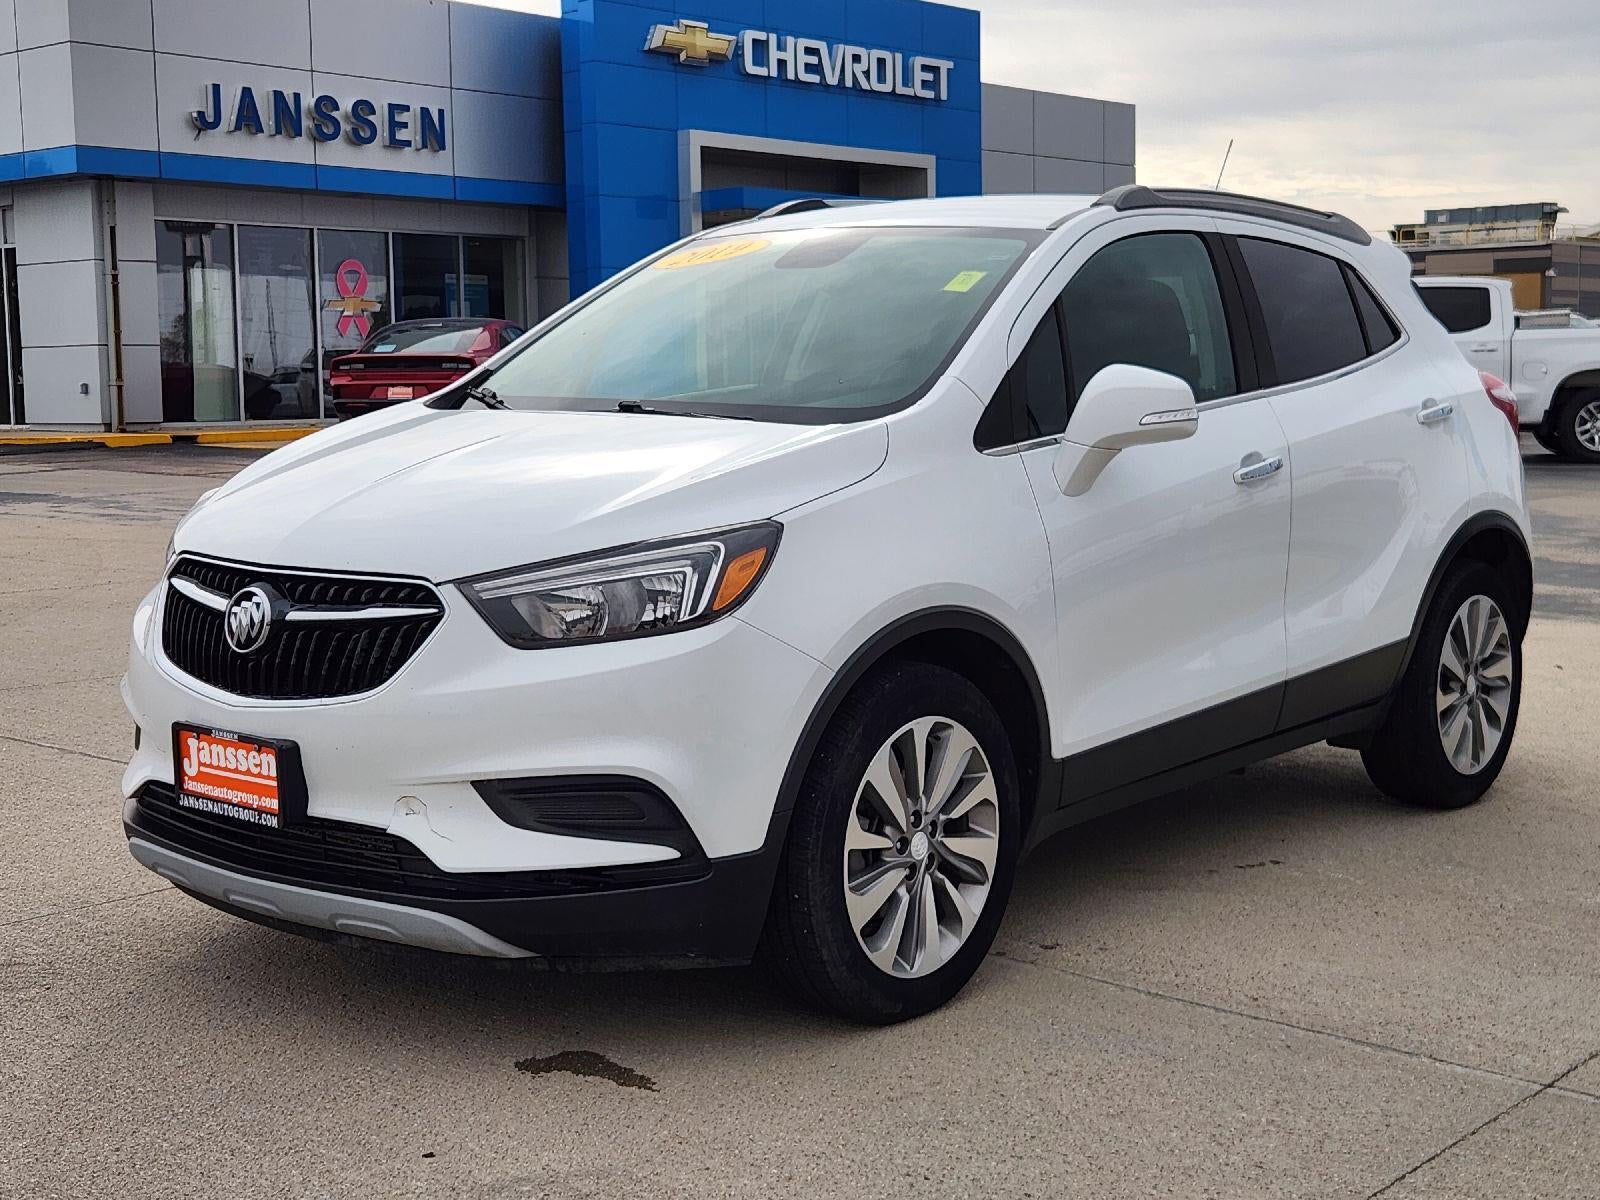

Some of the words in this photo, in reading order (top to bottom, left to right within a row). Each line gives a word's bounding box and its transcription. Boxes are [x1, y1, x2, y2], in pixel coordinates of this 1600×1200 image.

[740, 29, 954, 101] CHEVROLET
[192, 83, 447, 152] JANSSEN
[211, 729, 239, 740] JANSSEN
[183, 737, 278, 777] Janssen
[183, 776, 279, 809] Janssenautogroup.com
[179, 794, 279, 829] JANSSENAUTOGROUP.COM
